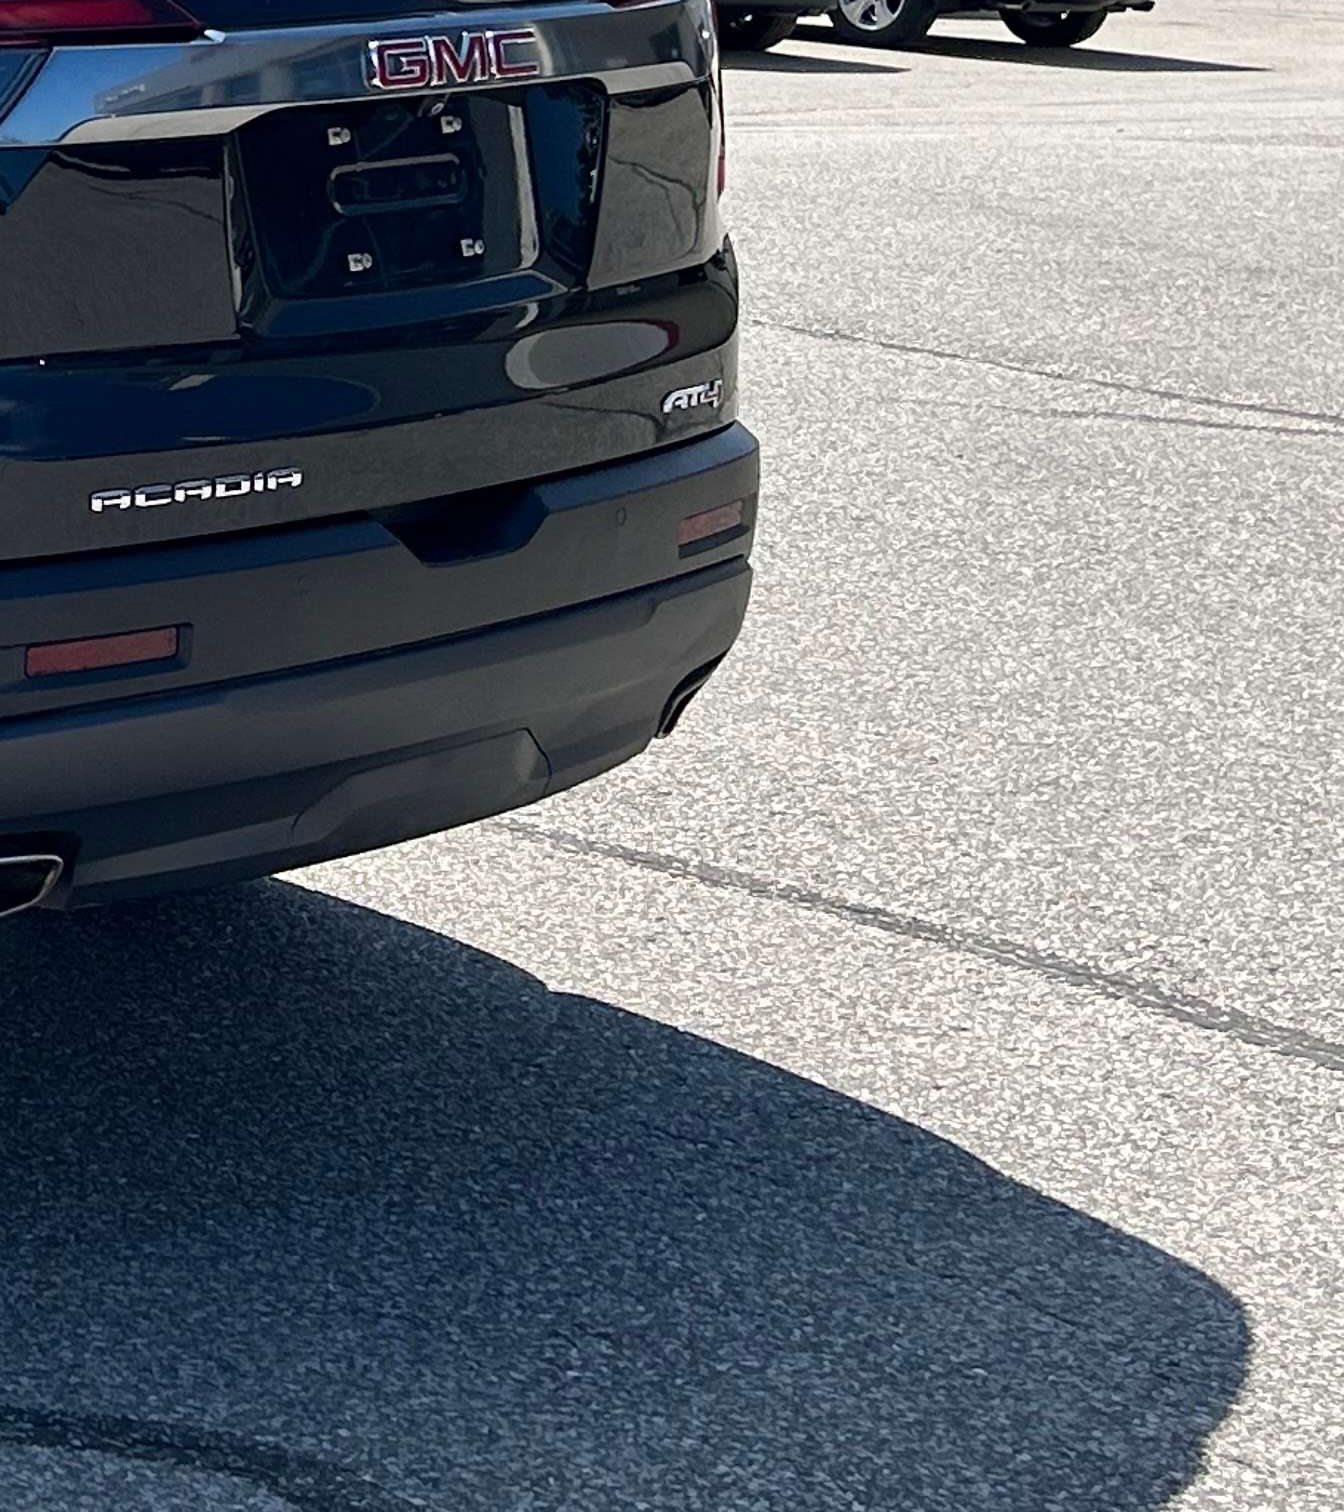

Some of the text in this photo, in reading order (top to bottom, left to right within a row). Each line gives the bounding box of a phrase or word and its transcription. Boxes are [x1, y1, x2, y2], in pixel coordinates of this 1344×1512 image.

[368, 27, 541, 89] GMC
[663, 379, 723, 413] AT4
[90, 466, 303, 512] ACADIA
